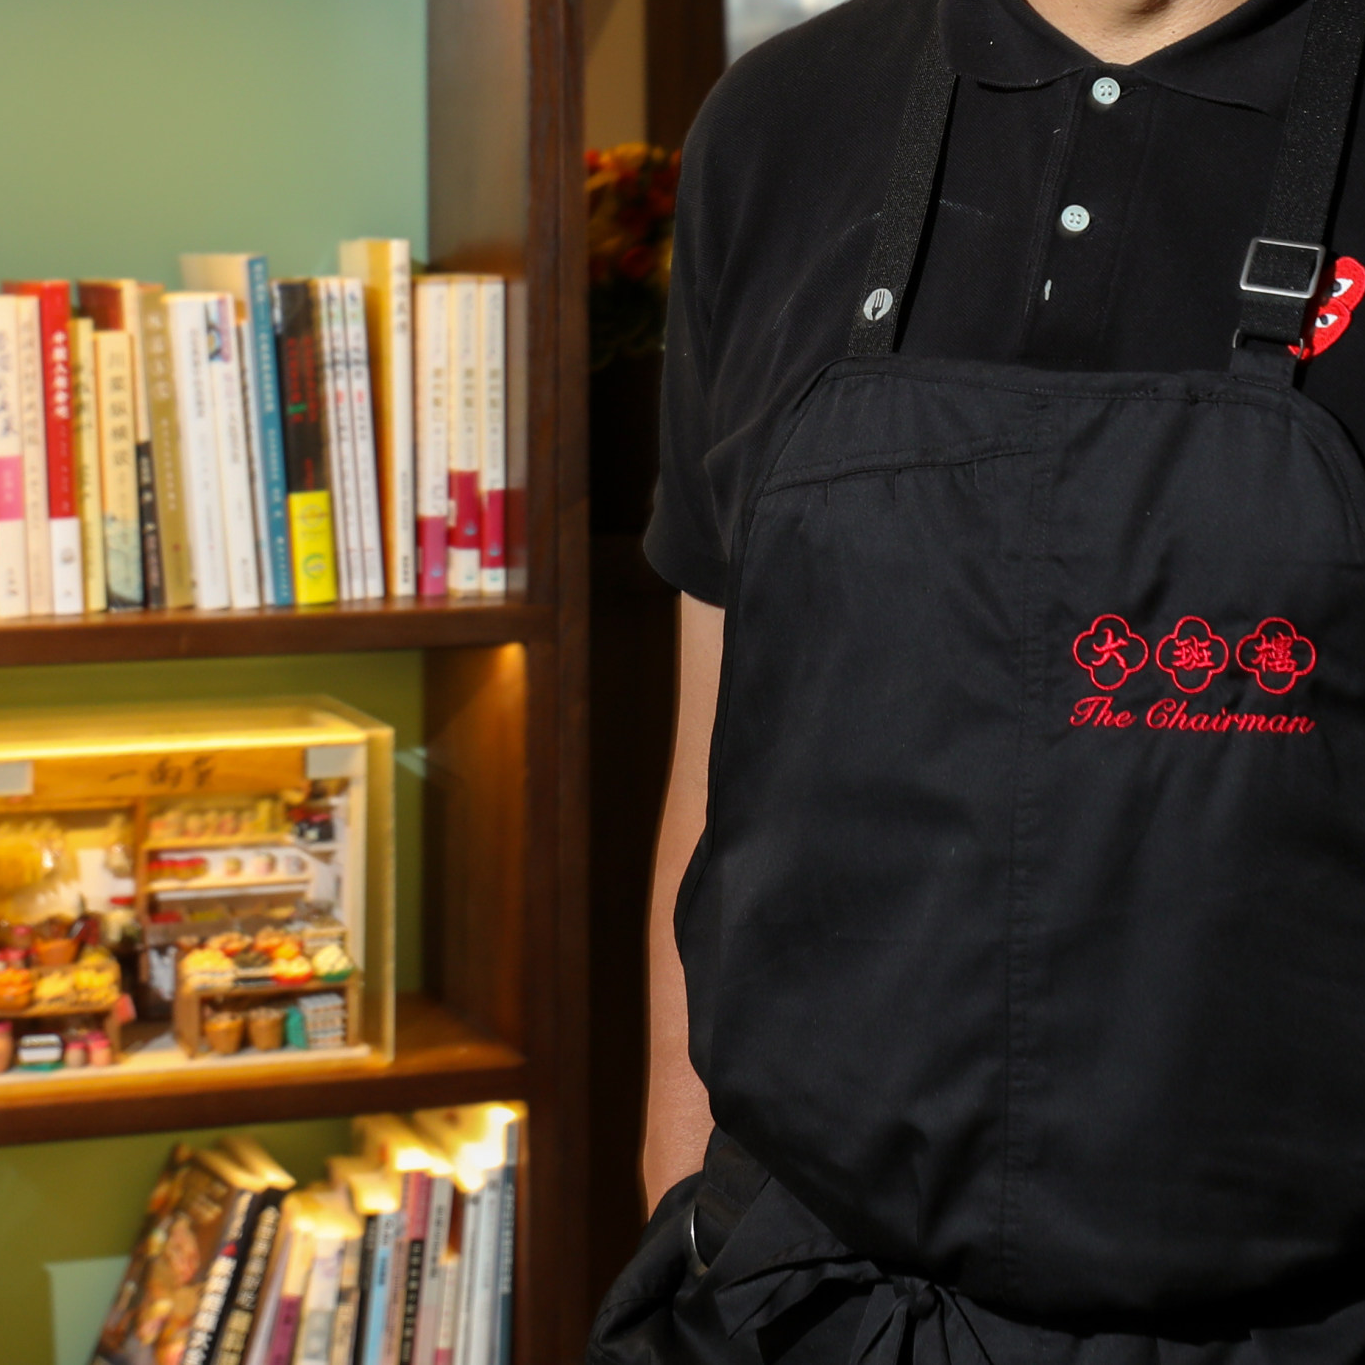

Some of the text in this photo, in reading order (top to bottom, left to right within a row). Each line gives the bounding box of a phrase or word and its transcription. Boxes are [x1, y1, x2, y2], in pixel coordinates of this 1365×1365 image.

[1091, 628, 1297, 673] 大班樓
[1070, 696, 1315, 735] The Chairman
